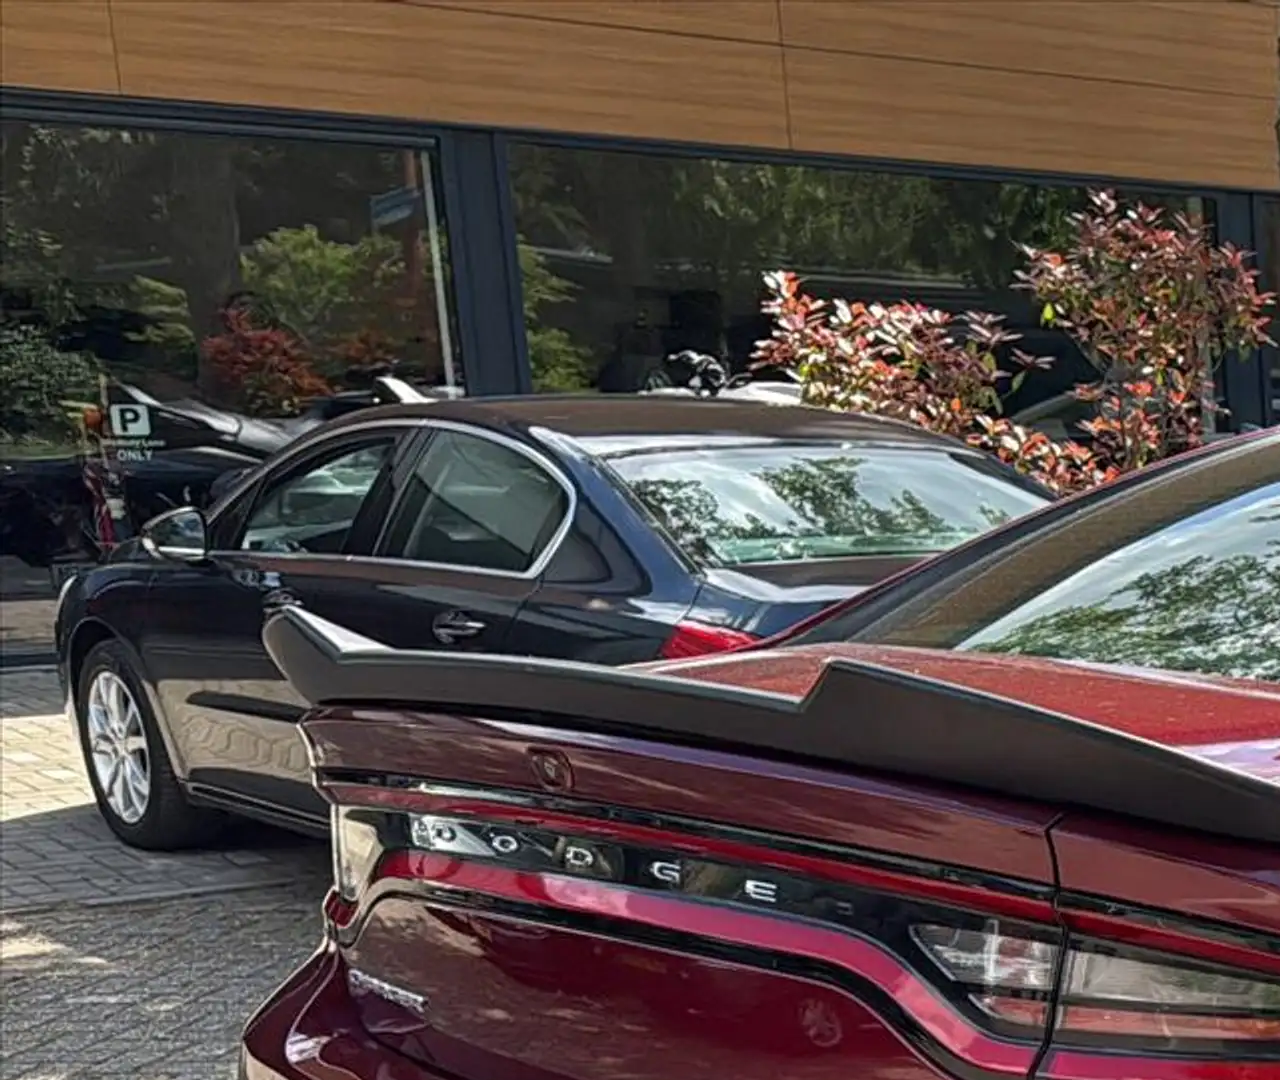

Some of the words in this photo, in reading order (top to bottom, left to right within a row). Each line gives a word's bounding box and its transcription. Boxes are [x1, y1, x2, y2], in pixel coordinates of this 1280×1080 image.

[119, 408, 141, 433] P
[116, 449, 153, 462] ONLY
[432, 822, 777, 903] DODGE
